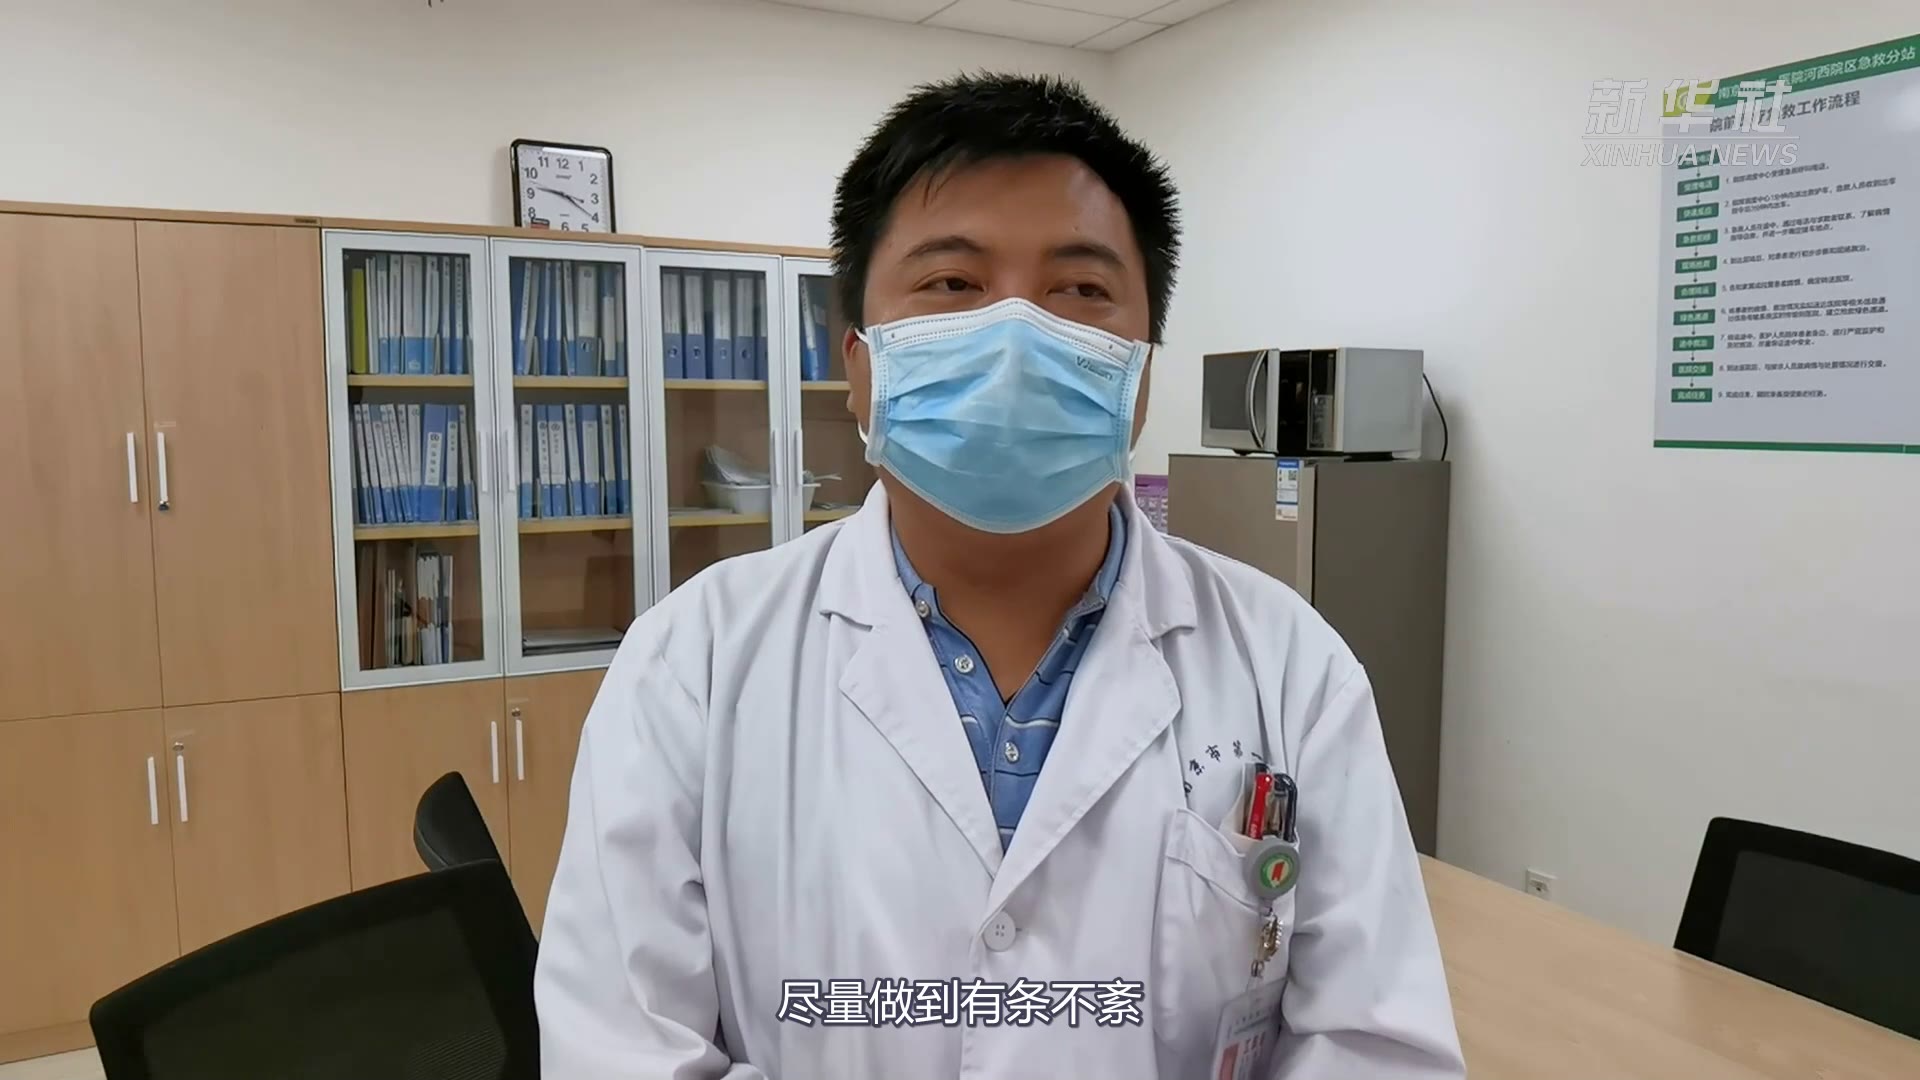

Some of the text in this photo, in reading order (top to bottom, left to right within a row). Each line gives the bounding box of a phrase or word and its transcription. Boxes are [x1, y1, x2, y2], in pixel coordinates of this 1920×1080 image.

[538, 156, 549, 168] 11
[556, 158, 569, 170] 12
[524, 167, 538, 179] 10
[590, 173, 598, 185] 2
[526, 187, 535, 199] 9
[591, 193, 599, 205] 3
[528, 207, 536, 219] 8
[591, 212, 600, 223] 4
